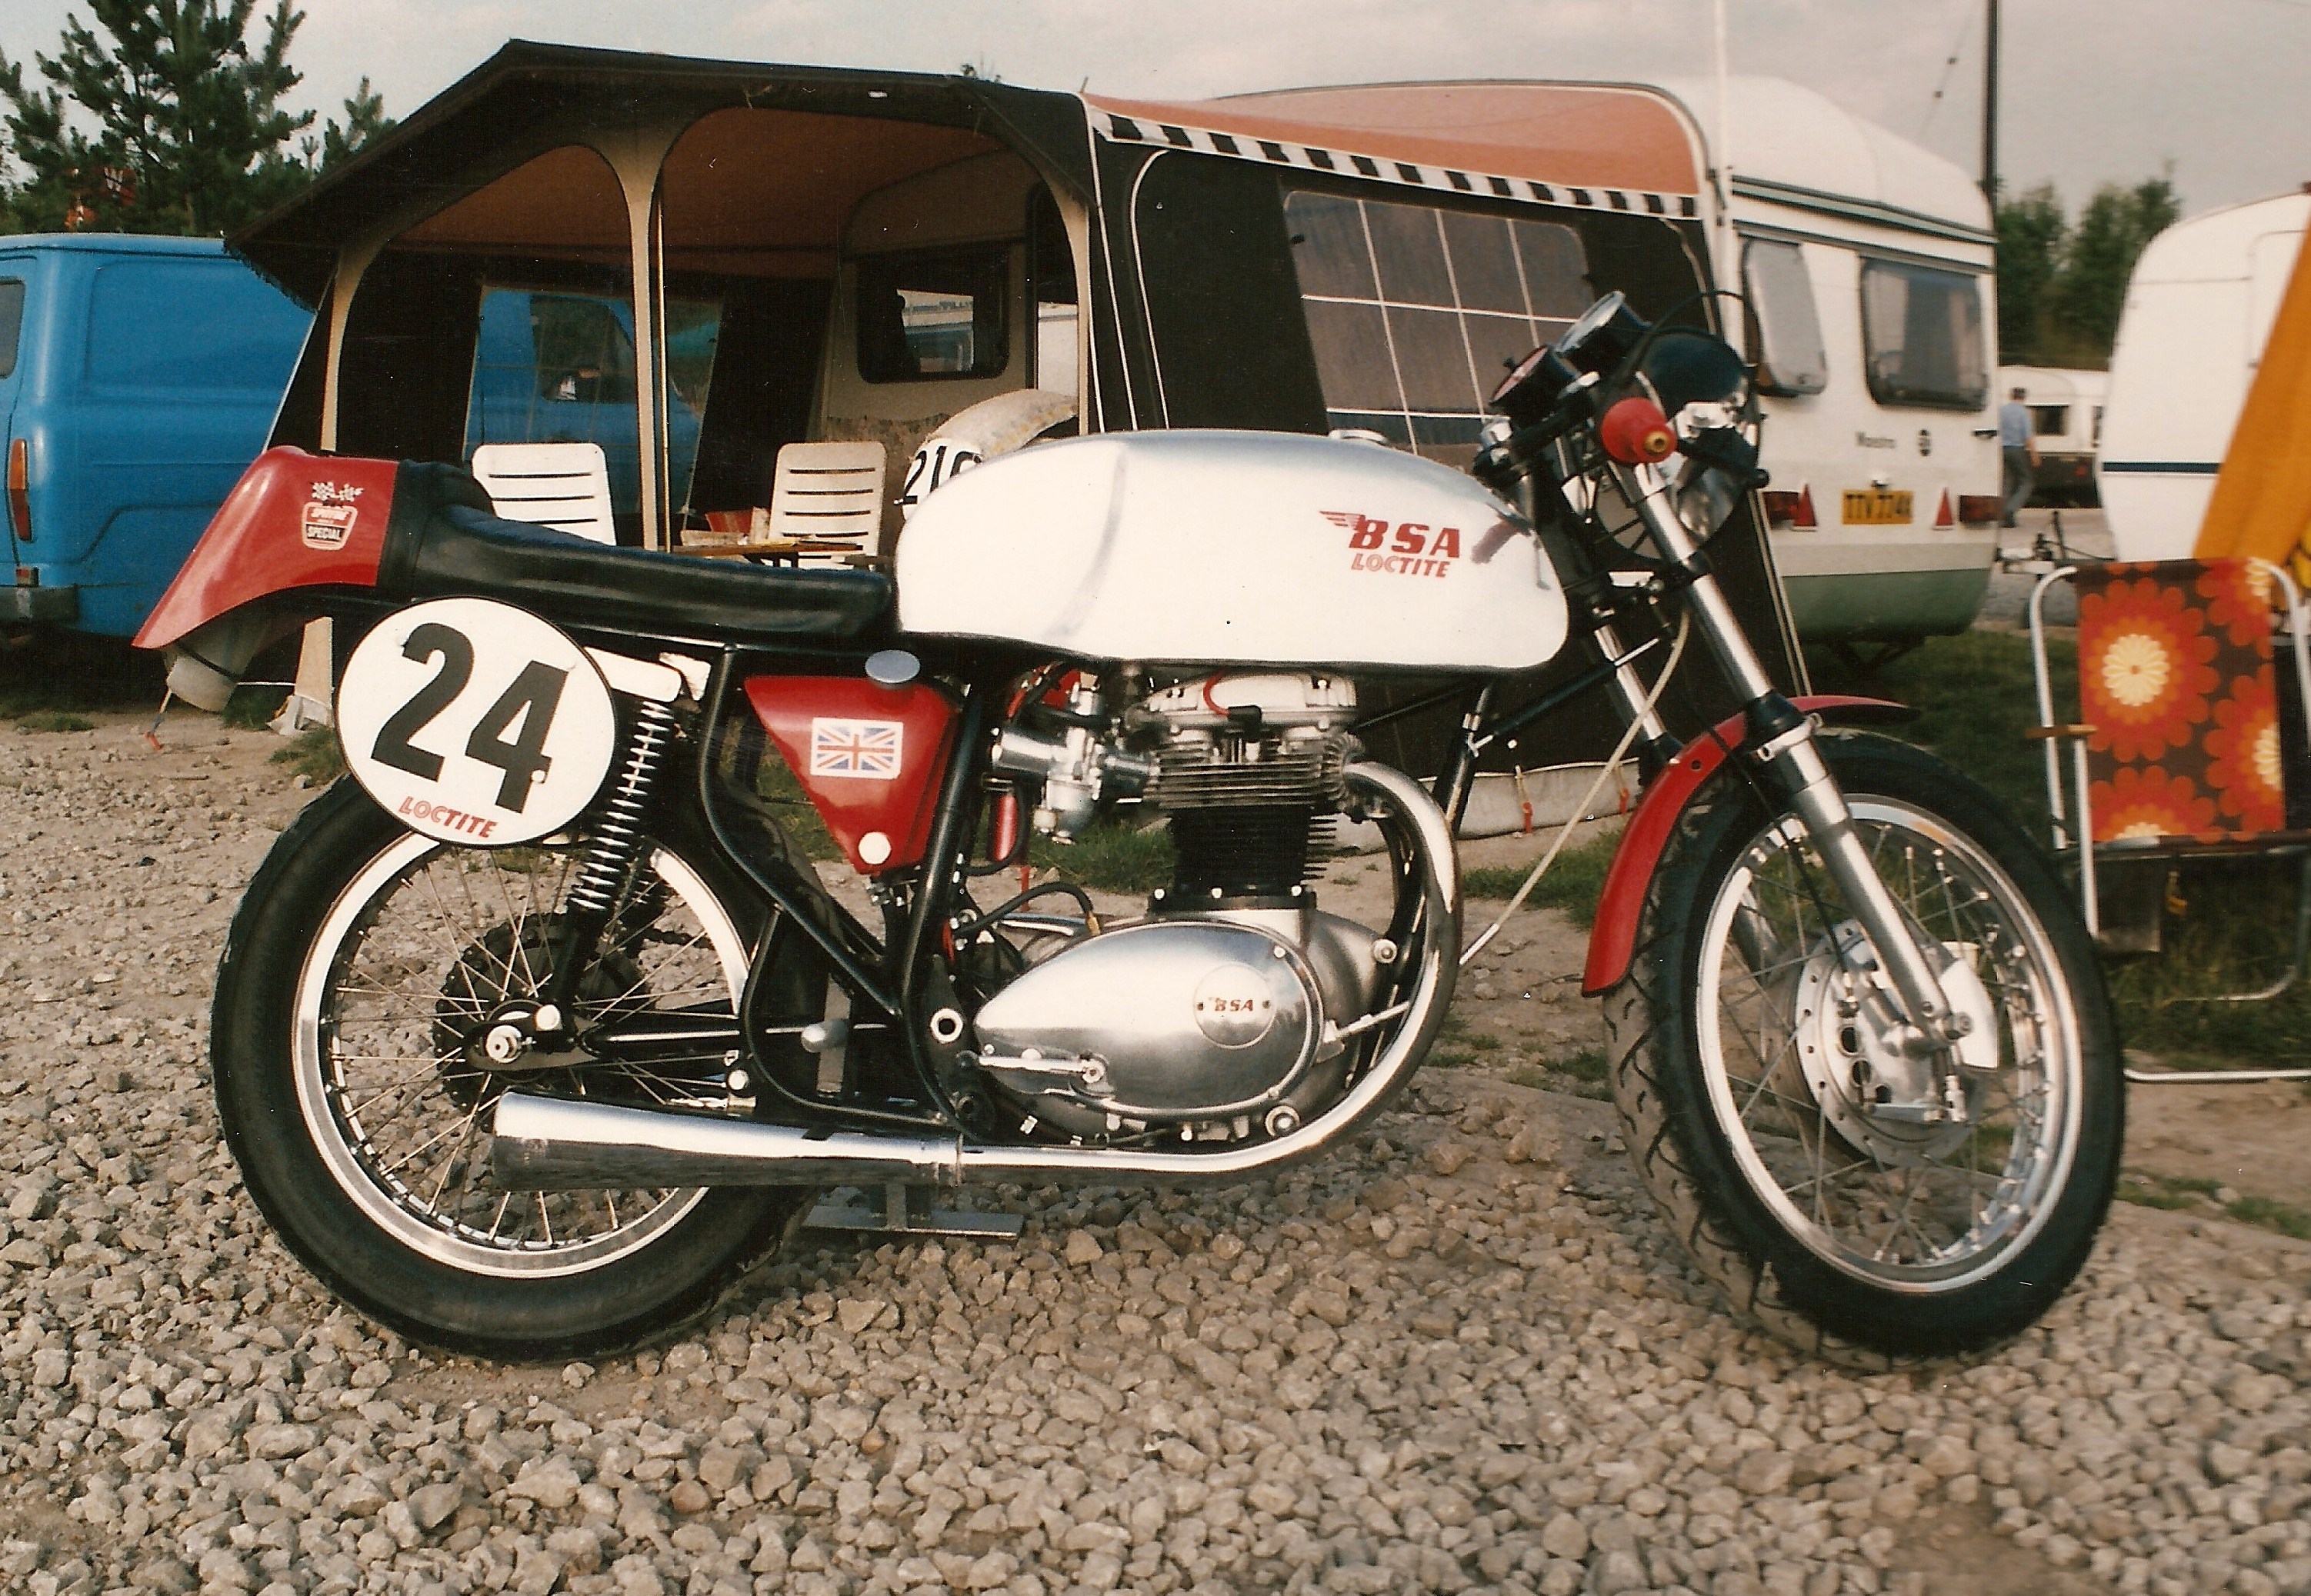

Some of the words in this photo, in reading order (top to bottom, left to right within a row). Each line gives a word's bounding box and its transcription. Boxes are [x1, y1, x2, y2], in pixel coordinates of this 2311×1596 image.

[307, 525, 341, 540] SPECIAL
[1349, 515, 1460, 558] BSA
[1351, 552, 1451, 578] LOCTITE
[370, 622, 569, 815] 24
[398, 795, 499, 838] LOCTITE
[1214, 998, 1254, 1012] BSA
